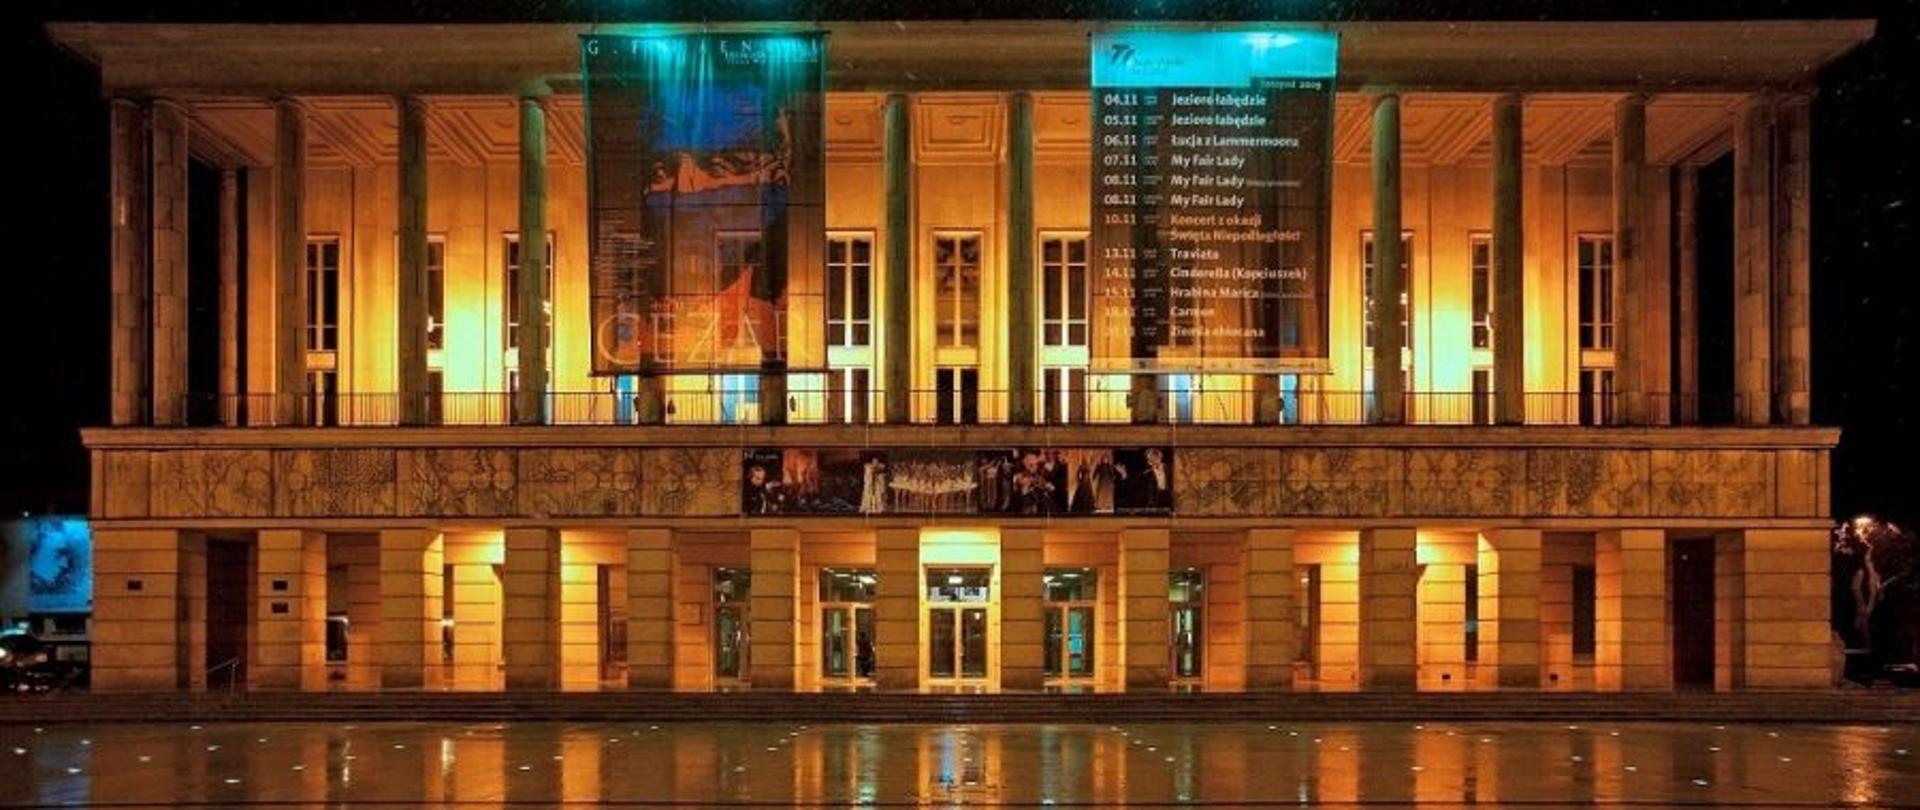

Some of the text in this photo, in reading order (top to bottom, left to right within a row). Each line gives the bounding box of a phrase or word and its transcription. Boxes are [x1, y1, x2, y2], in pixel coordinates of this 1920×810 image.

[1104, 94, 1138, 105] 04.11
[1171, 93, 1214, 107] Jezioro
[1104, 114, 1138, 126] 05.11
[1171, 113, 1214, 127] Jezioro
[1103, 134, 1137, 147] 06.11
[1213, 134, 1299, 148] Lammermooru
[1103, 154, 1137, 167] 07.11
[1170, 155, 1191, 168] My
[1192, 154, 1215, 167] Fair
[1216, 154, 1245, 168] Lady
[1103, 174, 1137, 186] 08.11
[1170, 174, 1191, 187] My
[1192, 174, 1215, 186] Fair
[1216, 174, 1245, 188] Lady
[1103, 194, 1137, 206] 08.11
[1170, 194, 1190, 207] My
[1191, 194, 1215, 206] Fair
[1216, 194, 1245, 208] Lady
[1104, 213, 1137, 225] 10.11
[1170, 214, 1217, 226] Koncert
[1226, 214, 1262, 228] okazji
[1104, 248, 1136, 260] 13.11
[1170, 248, 1219, 260] Traviata
[1104, 268, 1136, 279] 14.11
[1170, 267, 1230, 279] Cinderella
[1170, 287, 1218, 298] Hrabina
[1170, 306, 1215, 317] Carmen
